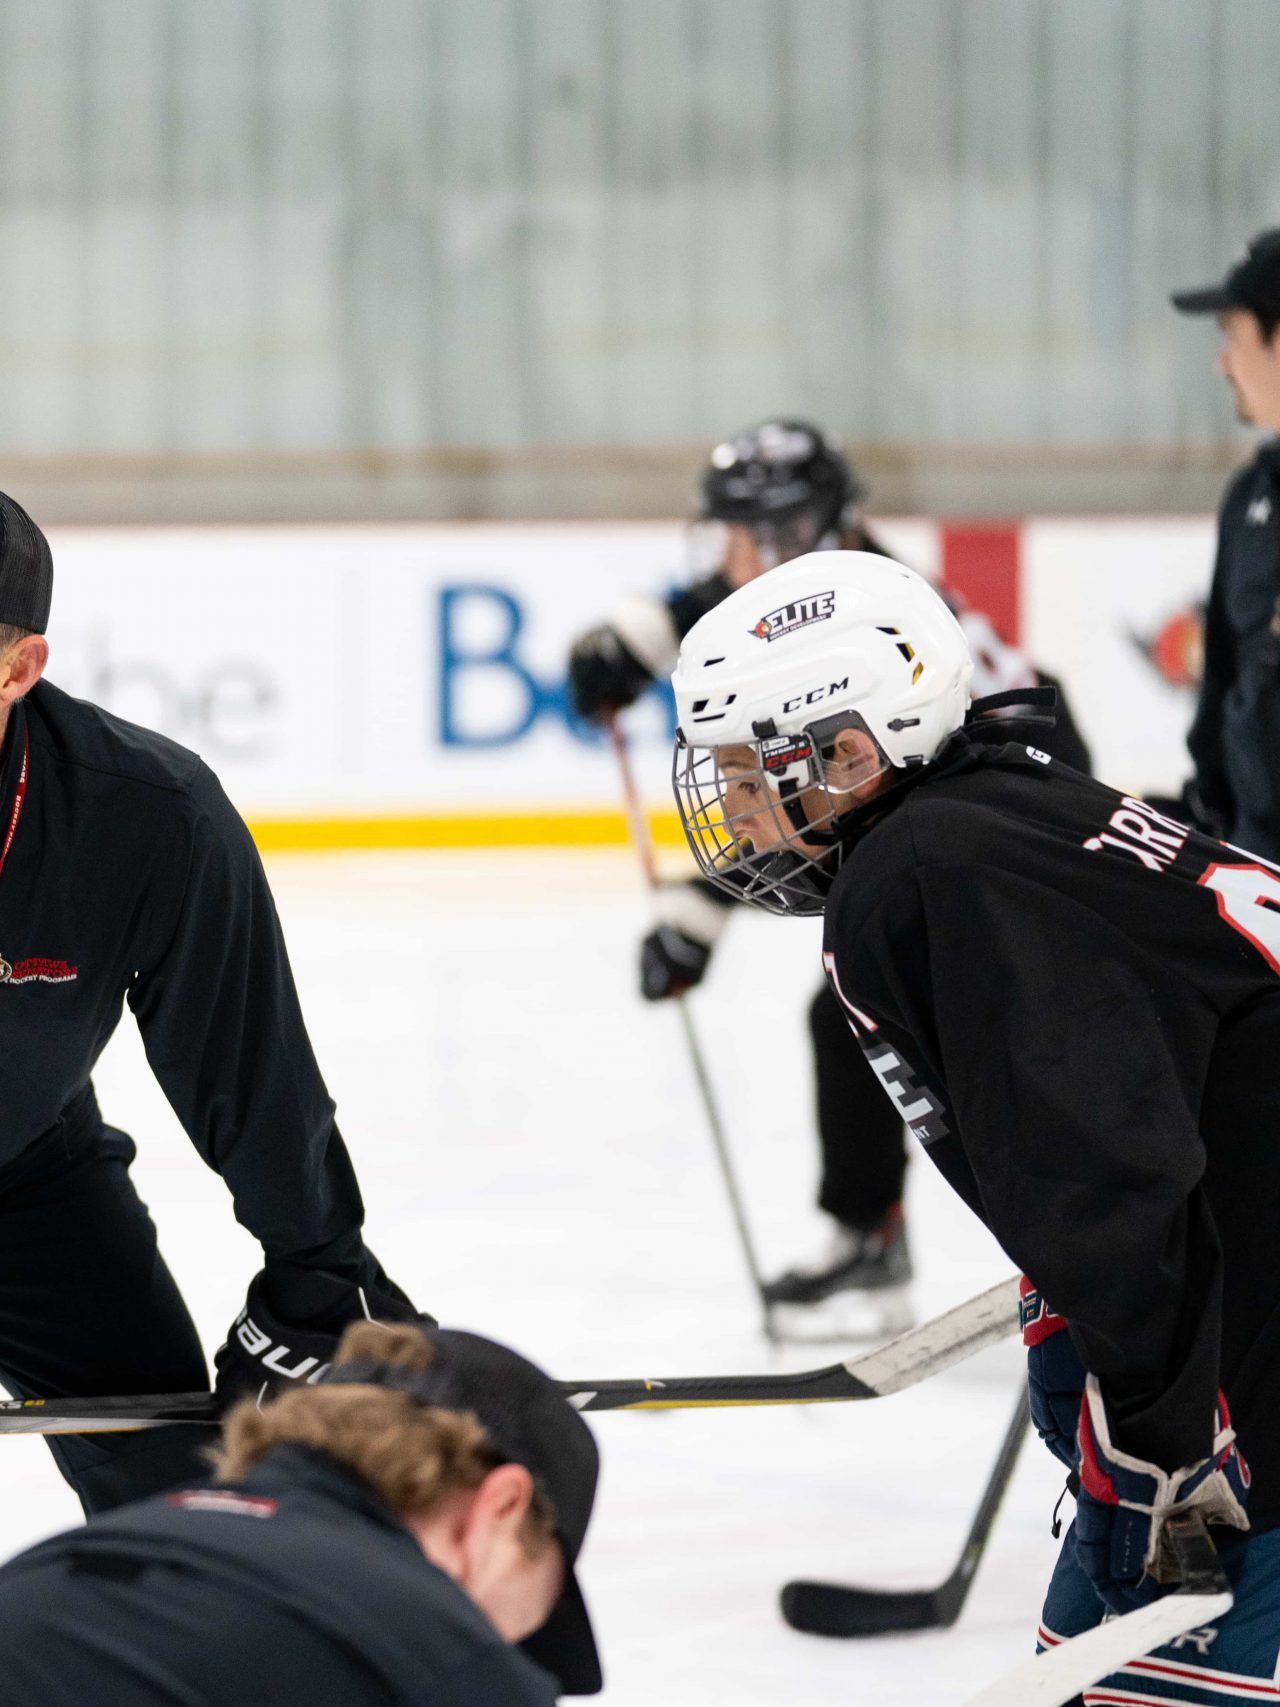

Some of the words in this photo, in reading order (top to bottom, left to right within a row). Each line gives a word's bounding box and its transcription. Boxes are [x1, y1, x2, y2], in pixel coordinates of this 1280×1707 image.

[765, 592, 834, 635] ELITE
[783, 677, 849, 714] CCM
[869, 1052, 934, 1123] E
